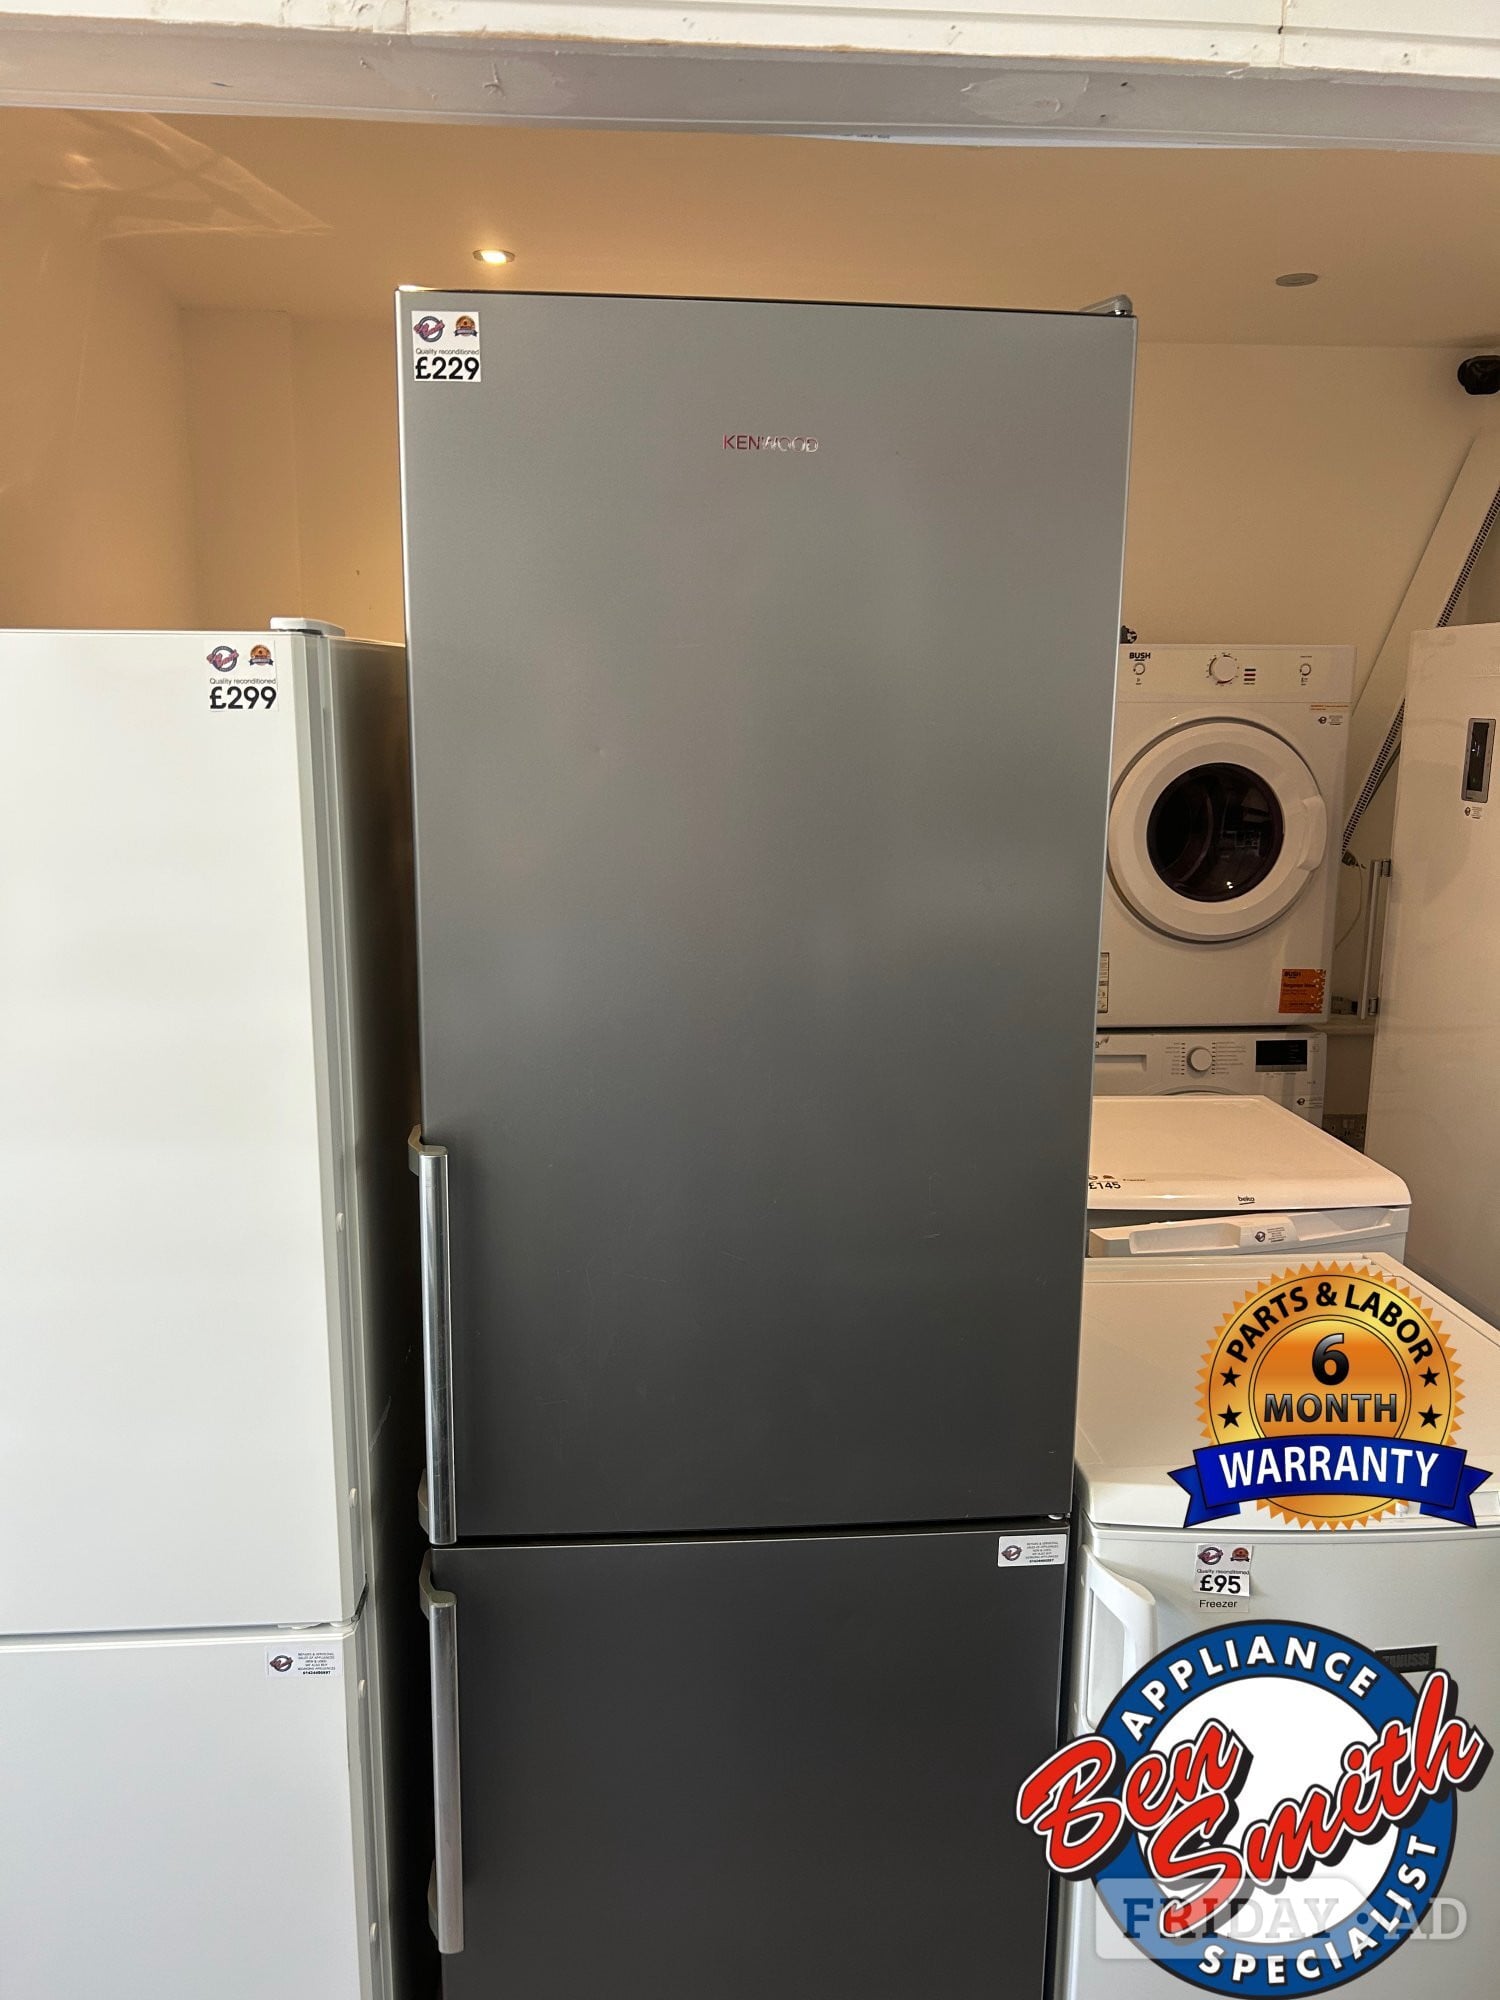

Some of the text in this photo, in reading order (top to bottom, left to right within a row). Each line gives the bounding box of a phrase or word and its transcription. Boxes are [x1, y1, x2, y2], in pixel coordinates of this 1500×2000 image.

[415, 356, 480, 380] £229
[722, 434, 819, 453] KENWOOD
[209, 678, 232, 686] Quality
[209, 686, 277, 709] £299
[1089, 1181, 1121, 1190] £145
[1199, 1574, 1241, 1594] £95
[1199, 1599, 1238, 1608] Freezer
